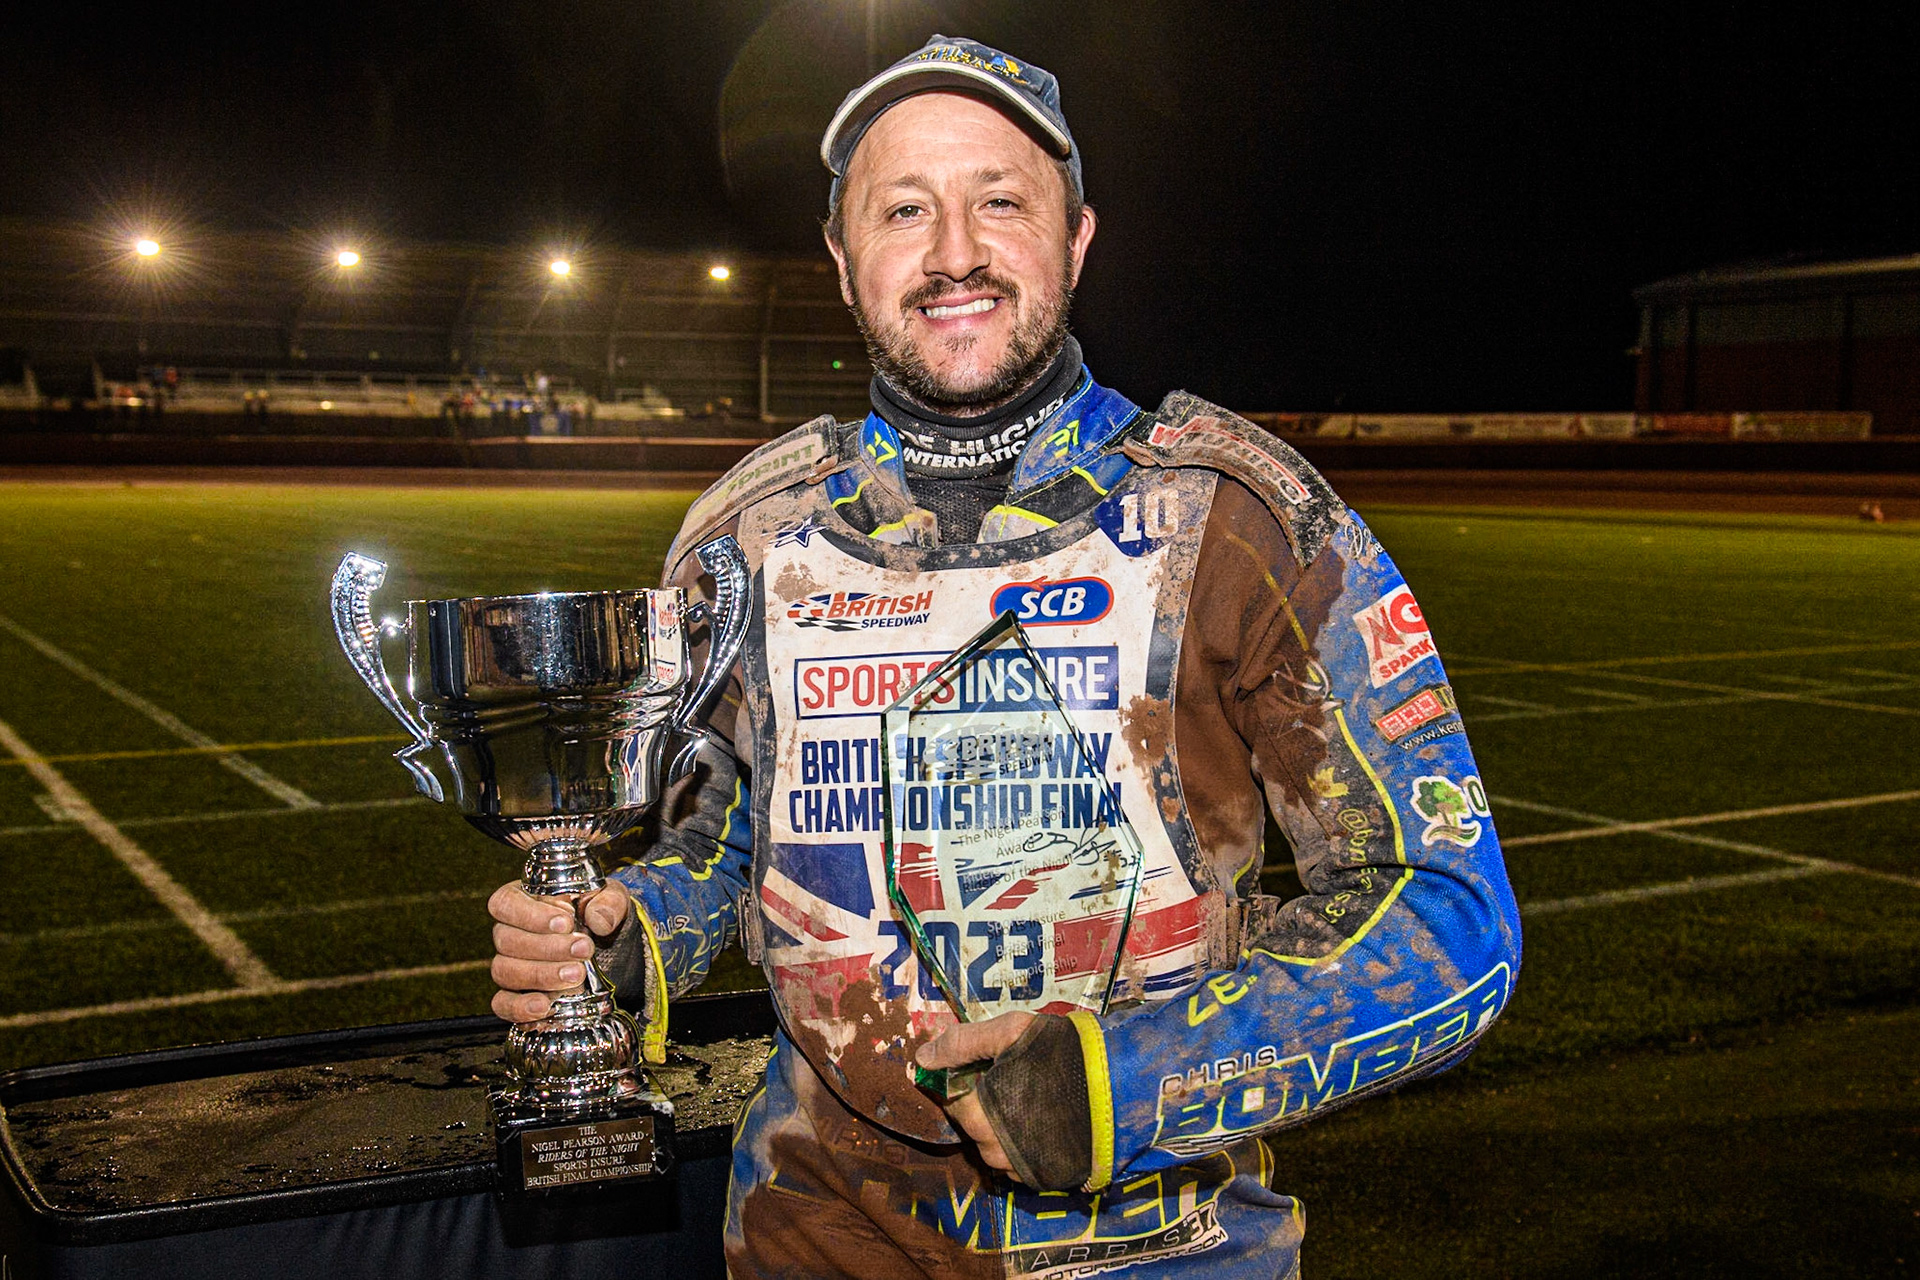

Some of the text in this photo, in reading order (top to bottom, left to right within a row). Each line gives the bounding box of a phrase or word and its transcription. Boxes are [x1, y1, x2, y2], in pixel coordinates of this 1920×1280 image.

[1119, 490, 1179, 543] 10
[827, 590, 933, 618] BRITISH
[1018, 587, 1086, 619] SCB
[861, 613, 930, 628] SPEEDWAY
[803, 656, 1109, 710] SPORTS INSURE
[789, 783, 1032, 833] CHAMPIONSHIP
[983, 818, 1016, 842] Nigel
[1017, 807, 1067, 828] Pearson
[1003, 867, 1016, 883] of
[987, 909, 1067, 940] Sports Insure
[877, 920, 1044, 1001] 2023
[996, 930, 1067, 962] British Final
[992, 955, 1079, 989] Championship
[1161, 1046, 1276, 1096] CHRIS
[531, 1131, 644, 1154] NIGEL PEARSON AWARD
[578, 1126, 598, 1136] THE
[537, 1141, 640, 1164] RIDERS OF THE NIGHT
[553, 1155, 626, 1173] SPORTS INSURE
[526, 1162, 653, 1187] BRITISH FINAL CHAMPIONSHIP
